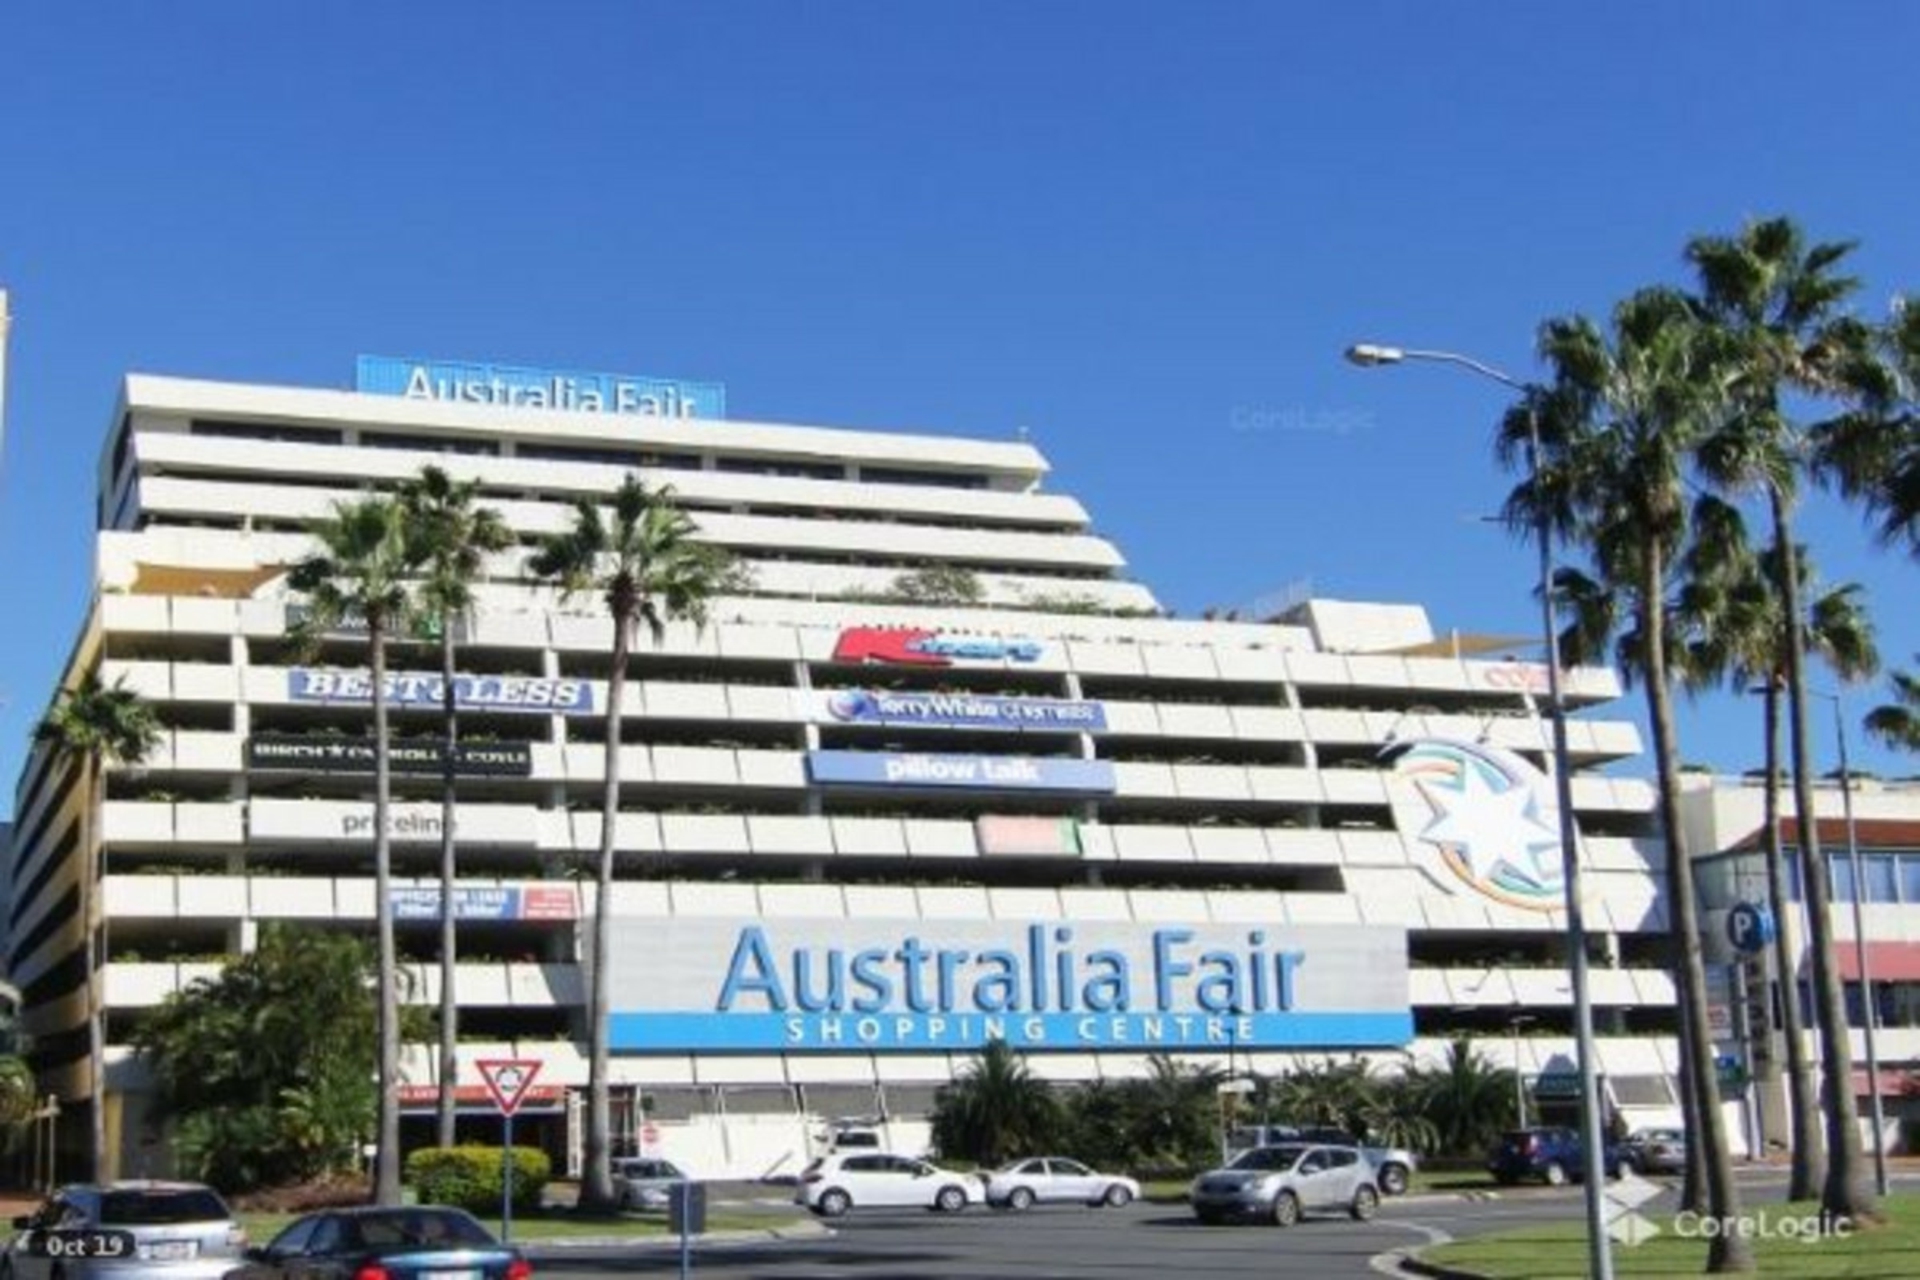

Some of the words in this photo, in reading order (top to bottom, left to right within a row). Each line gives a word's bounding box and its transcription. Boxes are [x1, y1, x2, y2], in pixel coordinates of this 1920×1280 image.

[404, 365, 604, 414] Australia
[613, 382, 697, 418] Fair
[467, 678, 580, 707] LESS
[885, 754, 976, 781] pillow
[981, 756, 1041, 781] talk
[1733, 911, 1751, 944] P
[716, 924, 1131, 1014] Australia
[1151, 929, 1305, 1014] Fair
[786, 1017, 1047, 1041] SHOPPING
[1078, 1016, 1255, 1040] CENTRE
